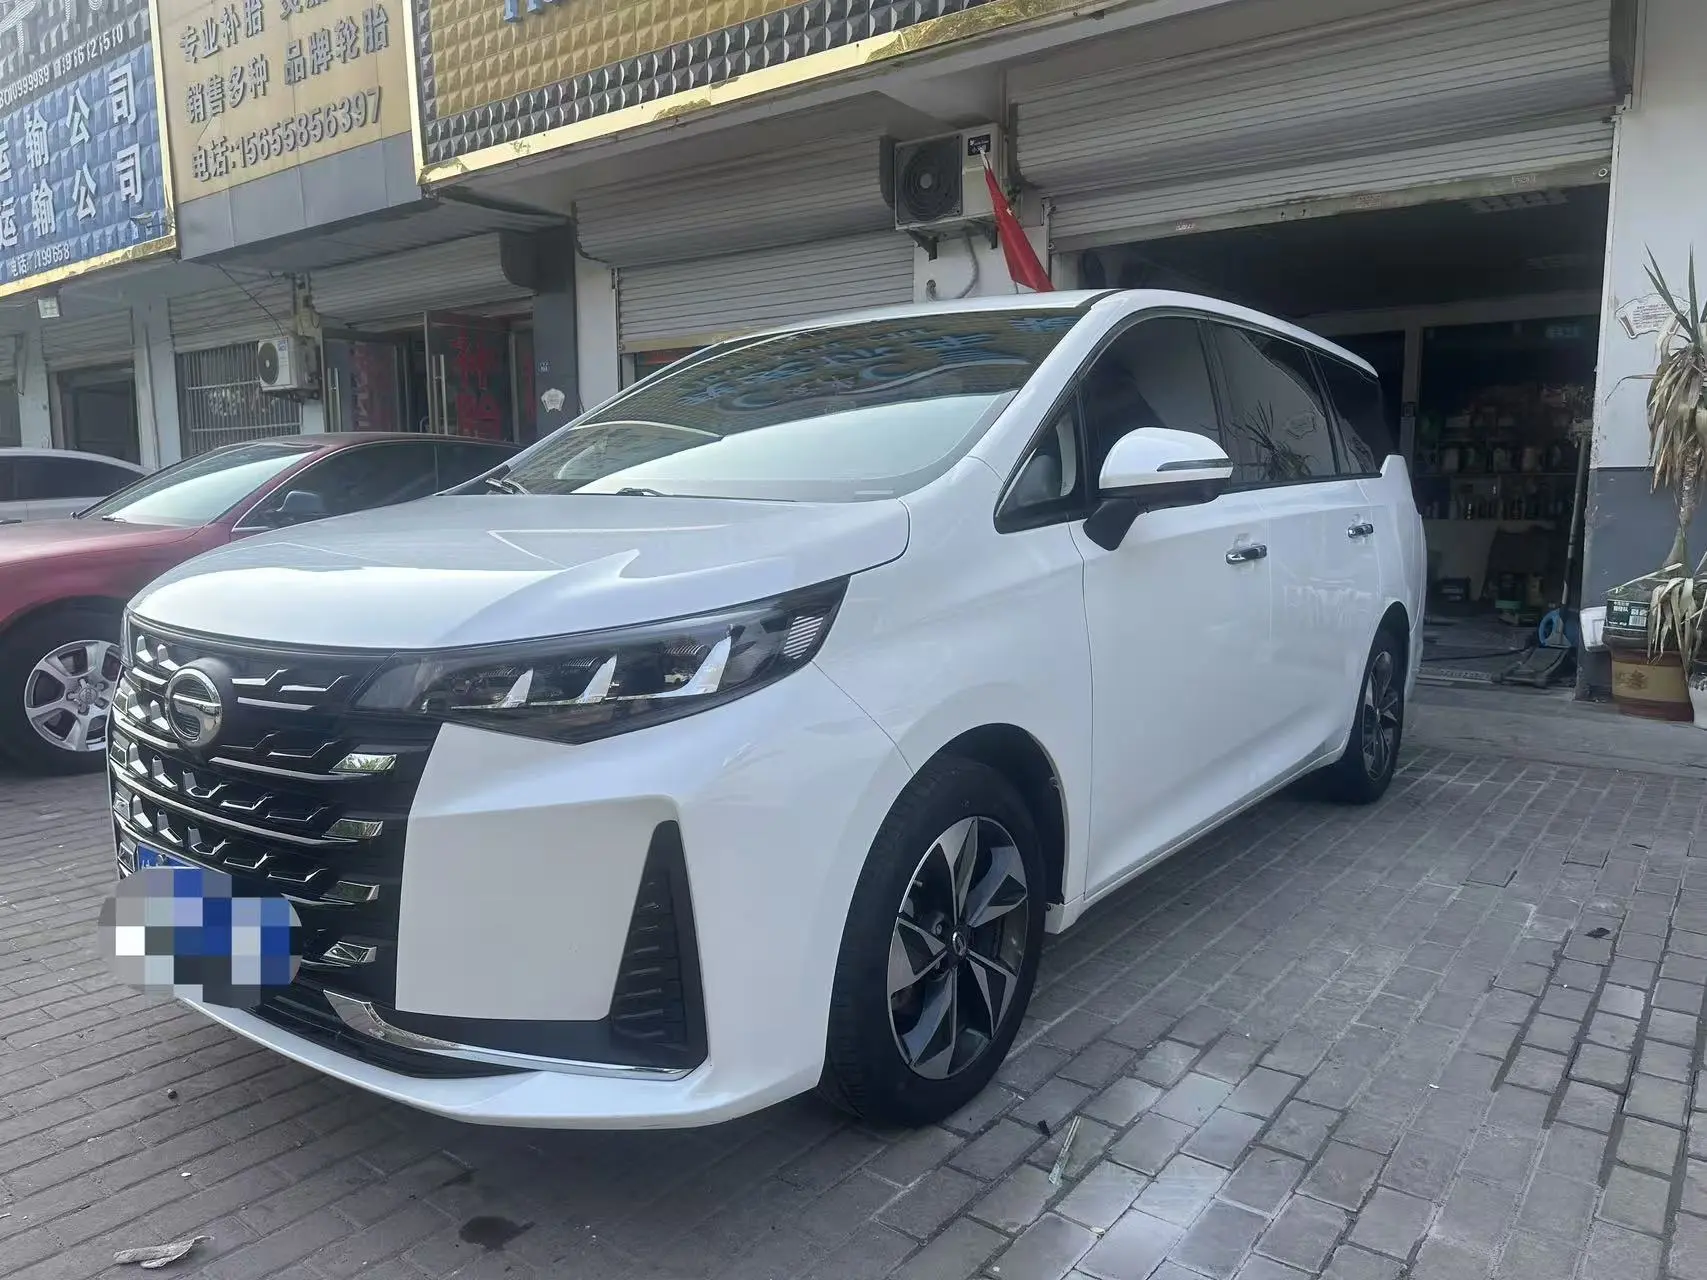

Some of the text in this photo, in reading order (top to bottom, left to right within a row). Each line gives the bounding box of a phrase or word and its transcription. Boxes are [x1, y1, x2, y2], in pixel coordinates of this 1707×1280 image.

[181, 0, 265, 63] 专业补胎
[186, 4, 390, 124] 销售多种 品牌轮胎
[192, 85, 383, 182] 电话:15655856397
